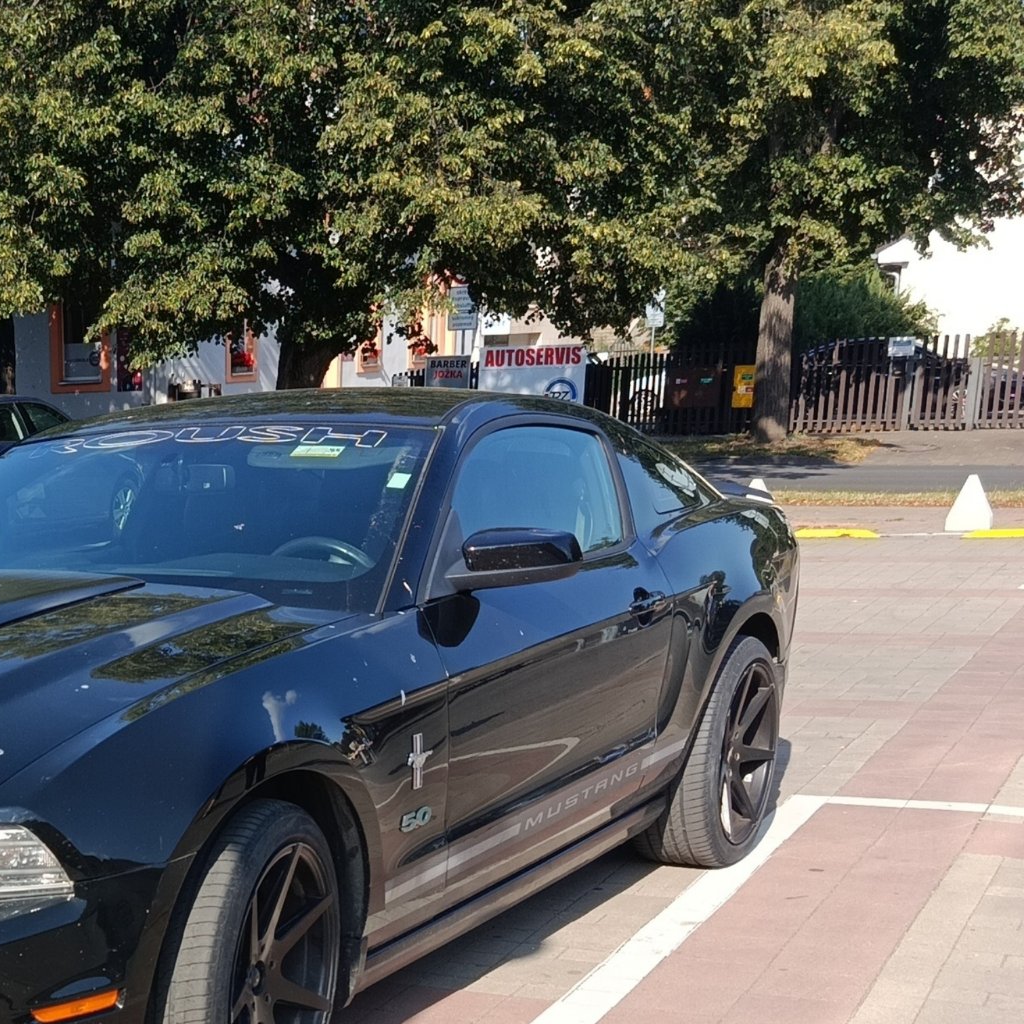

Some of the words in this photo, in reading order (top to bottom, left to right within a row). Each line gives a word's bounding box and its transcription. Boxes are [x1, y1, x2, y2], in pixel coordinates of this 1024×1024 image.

[430, 360, 467, 369] BARBER
[484, 346, 582, 368] AUTOSERVIS
[433, 369, 463, 379] JOŽKA
[524, 762, 638, 831] MUSTANG
